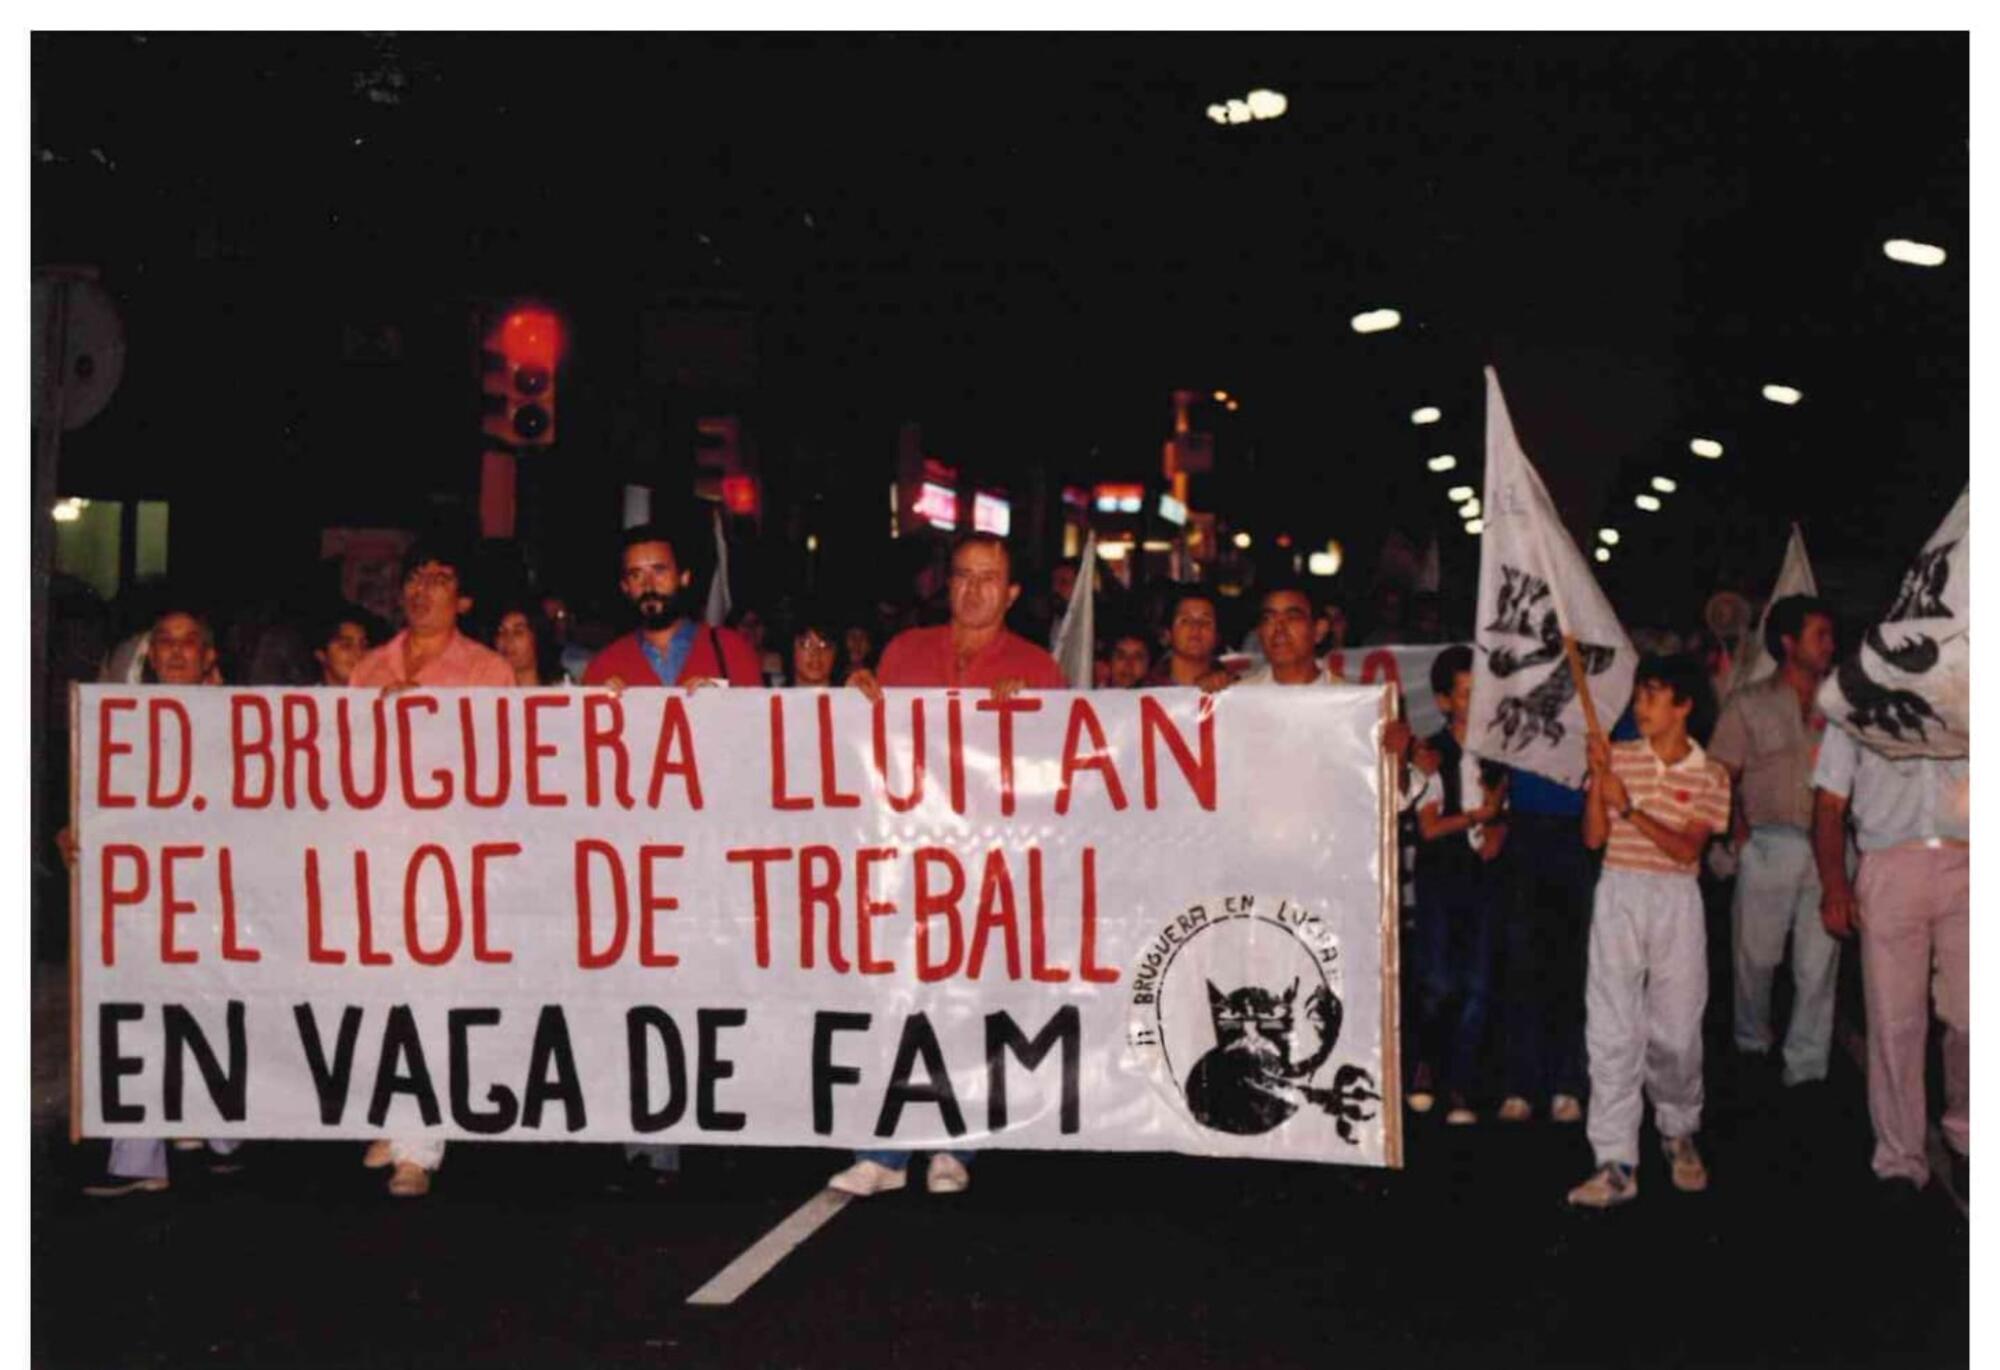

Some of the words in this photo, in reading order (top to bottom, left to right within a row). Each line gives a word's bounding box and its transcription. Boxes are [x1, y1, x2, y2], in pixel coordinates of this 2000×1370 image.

[97, 696, 207, 811] ED.
[230, 694, 704, 811] BRUGUERA
[101, 843, 261, 966] PEL
[304, 842, 523, 966] LLOC
[574, 838, 685, 969] DE
[726, 844, 1121, 984] TREBALL
[1224, 894, 1255, 913] EN
[99, 1000, 248, 1125] EN
[293, 1001, 588, 1134] VAGA
[626, 1004, 747, 1134] DE
[812, 1005, 1081, 1138] FAM
